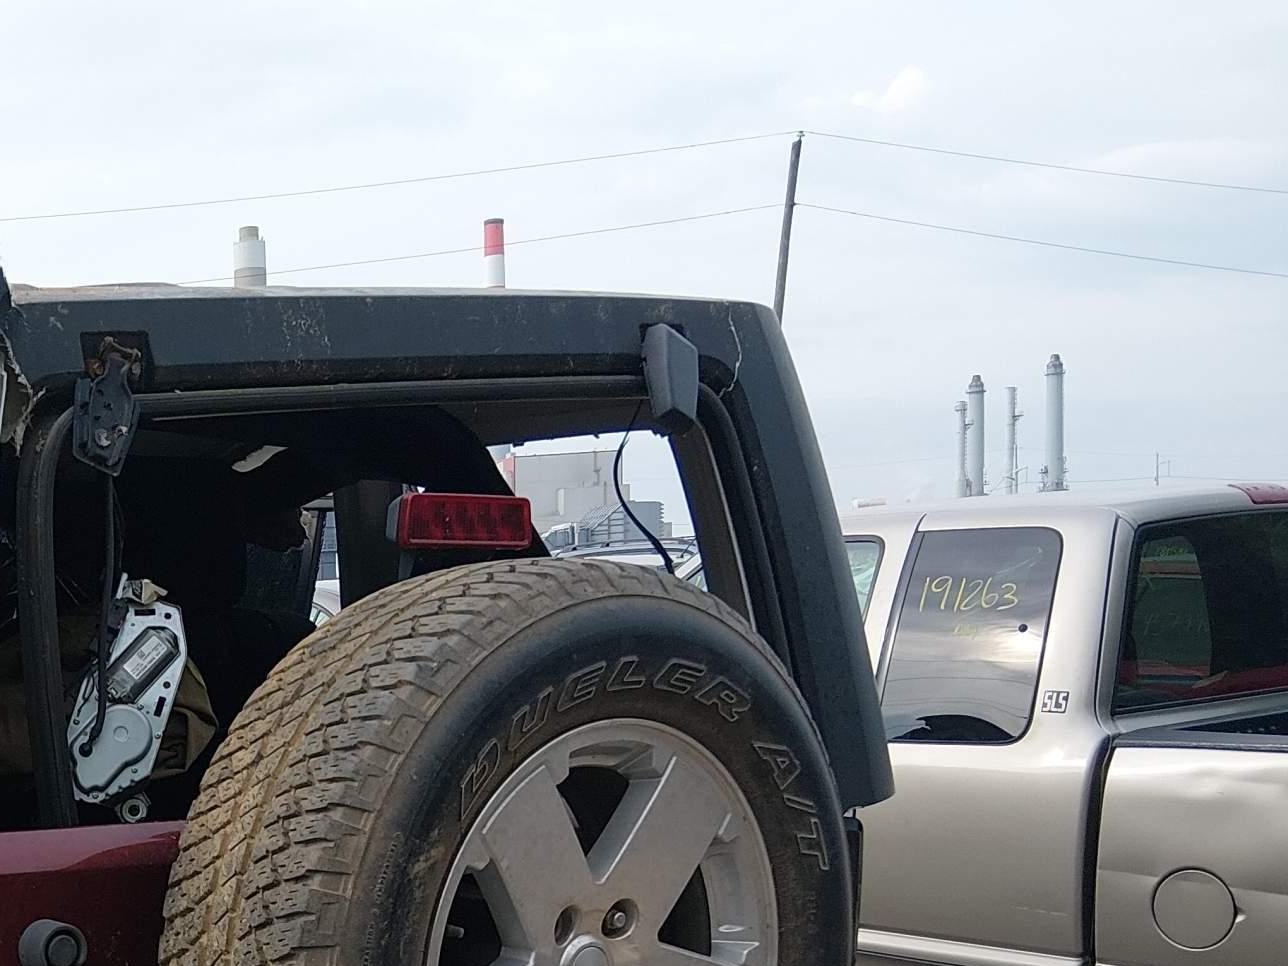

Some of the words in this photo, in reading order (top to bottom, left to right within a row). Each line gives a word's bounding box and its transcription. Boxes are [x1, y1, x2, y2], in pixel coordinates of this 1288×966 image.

[919, 575, 1018, 613] 191263
[1041, 690, 1069, 713] SLS
[460, 655, 752, 832] DUELER
